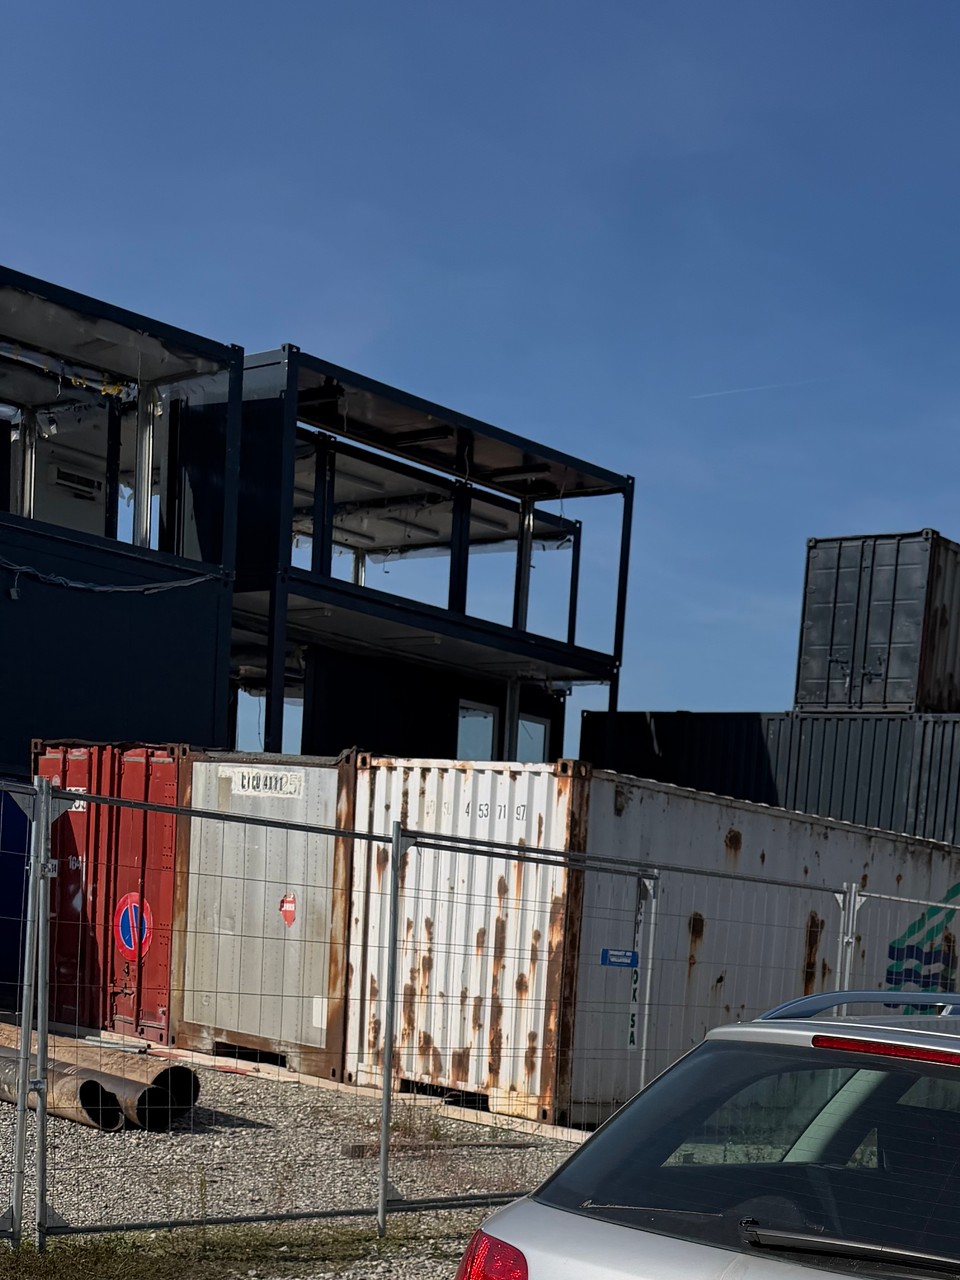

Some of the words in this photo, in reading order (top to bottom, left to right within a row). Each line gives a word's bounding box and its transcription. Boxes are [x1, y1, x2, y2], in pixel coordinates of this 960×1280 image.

[478, 803, 489, 818] 53
[498, 804, 506, 819] 71
[516, 805, 526, 820] 97
